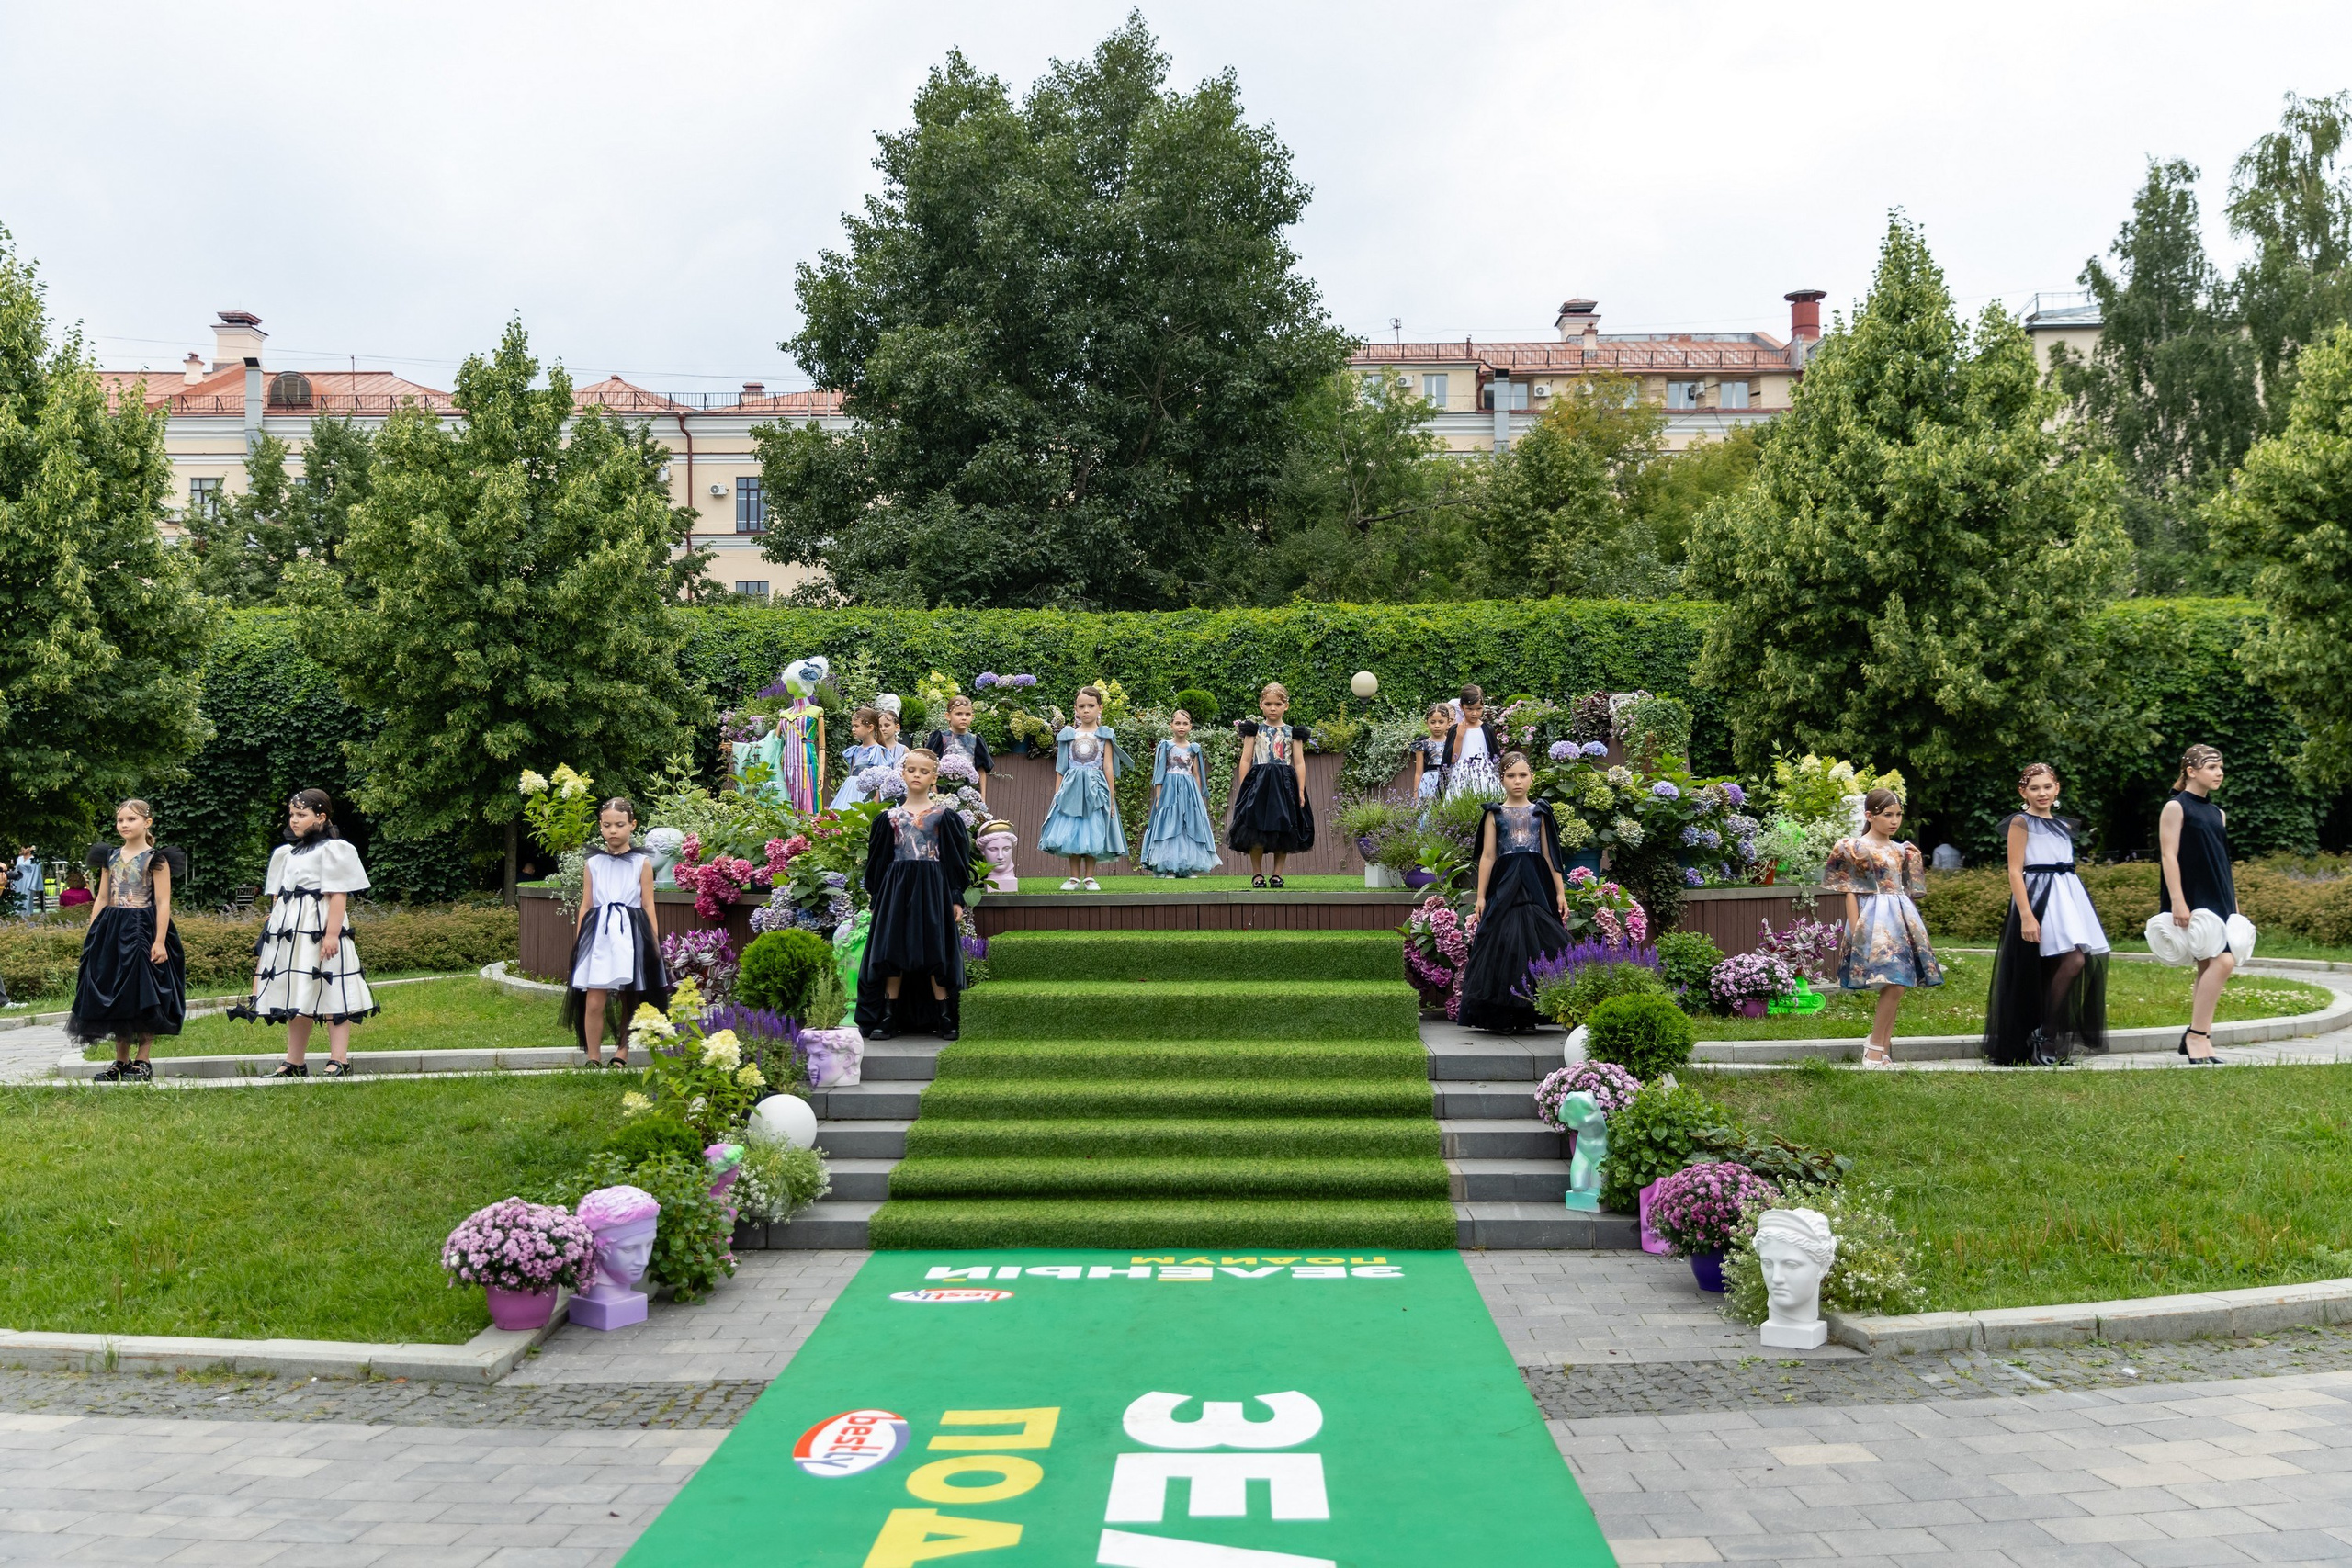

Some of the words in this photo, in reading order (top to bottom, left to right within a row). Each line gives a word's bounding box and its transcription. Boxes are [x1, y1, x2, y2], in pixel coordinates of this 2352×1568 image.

[1130, 1256, 1387, 1266] ПОДИУМ
[904, 1289, 1002, 1302] bestly
[796, 1415, 901, 1469] bestly
